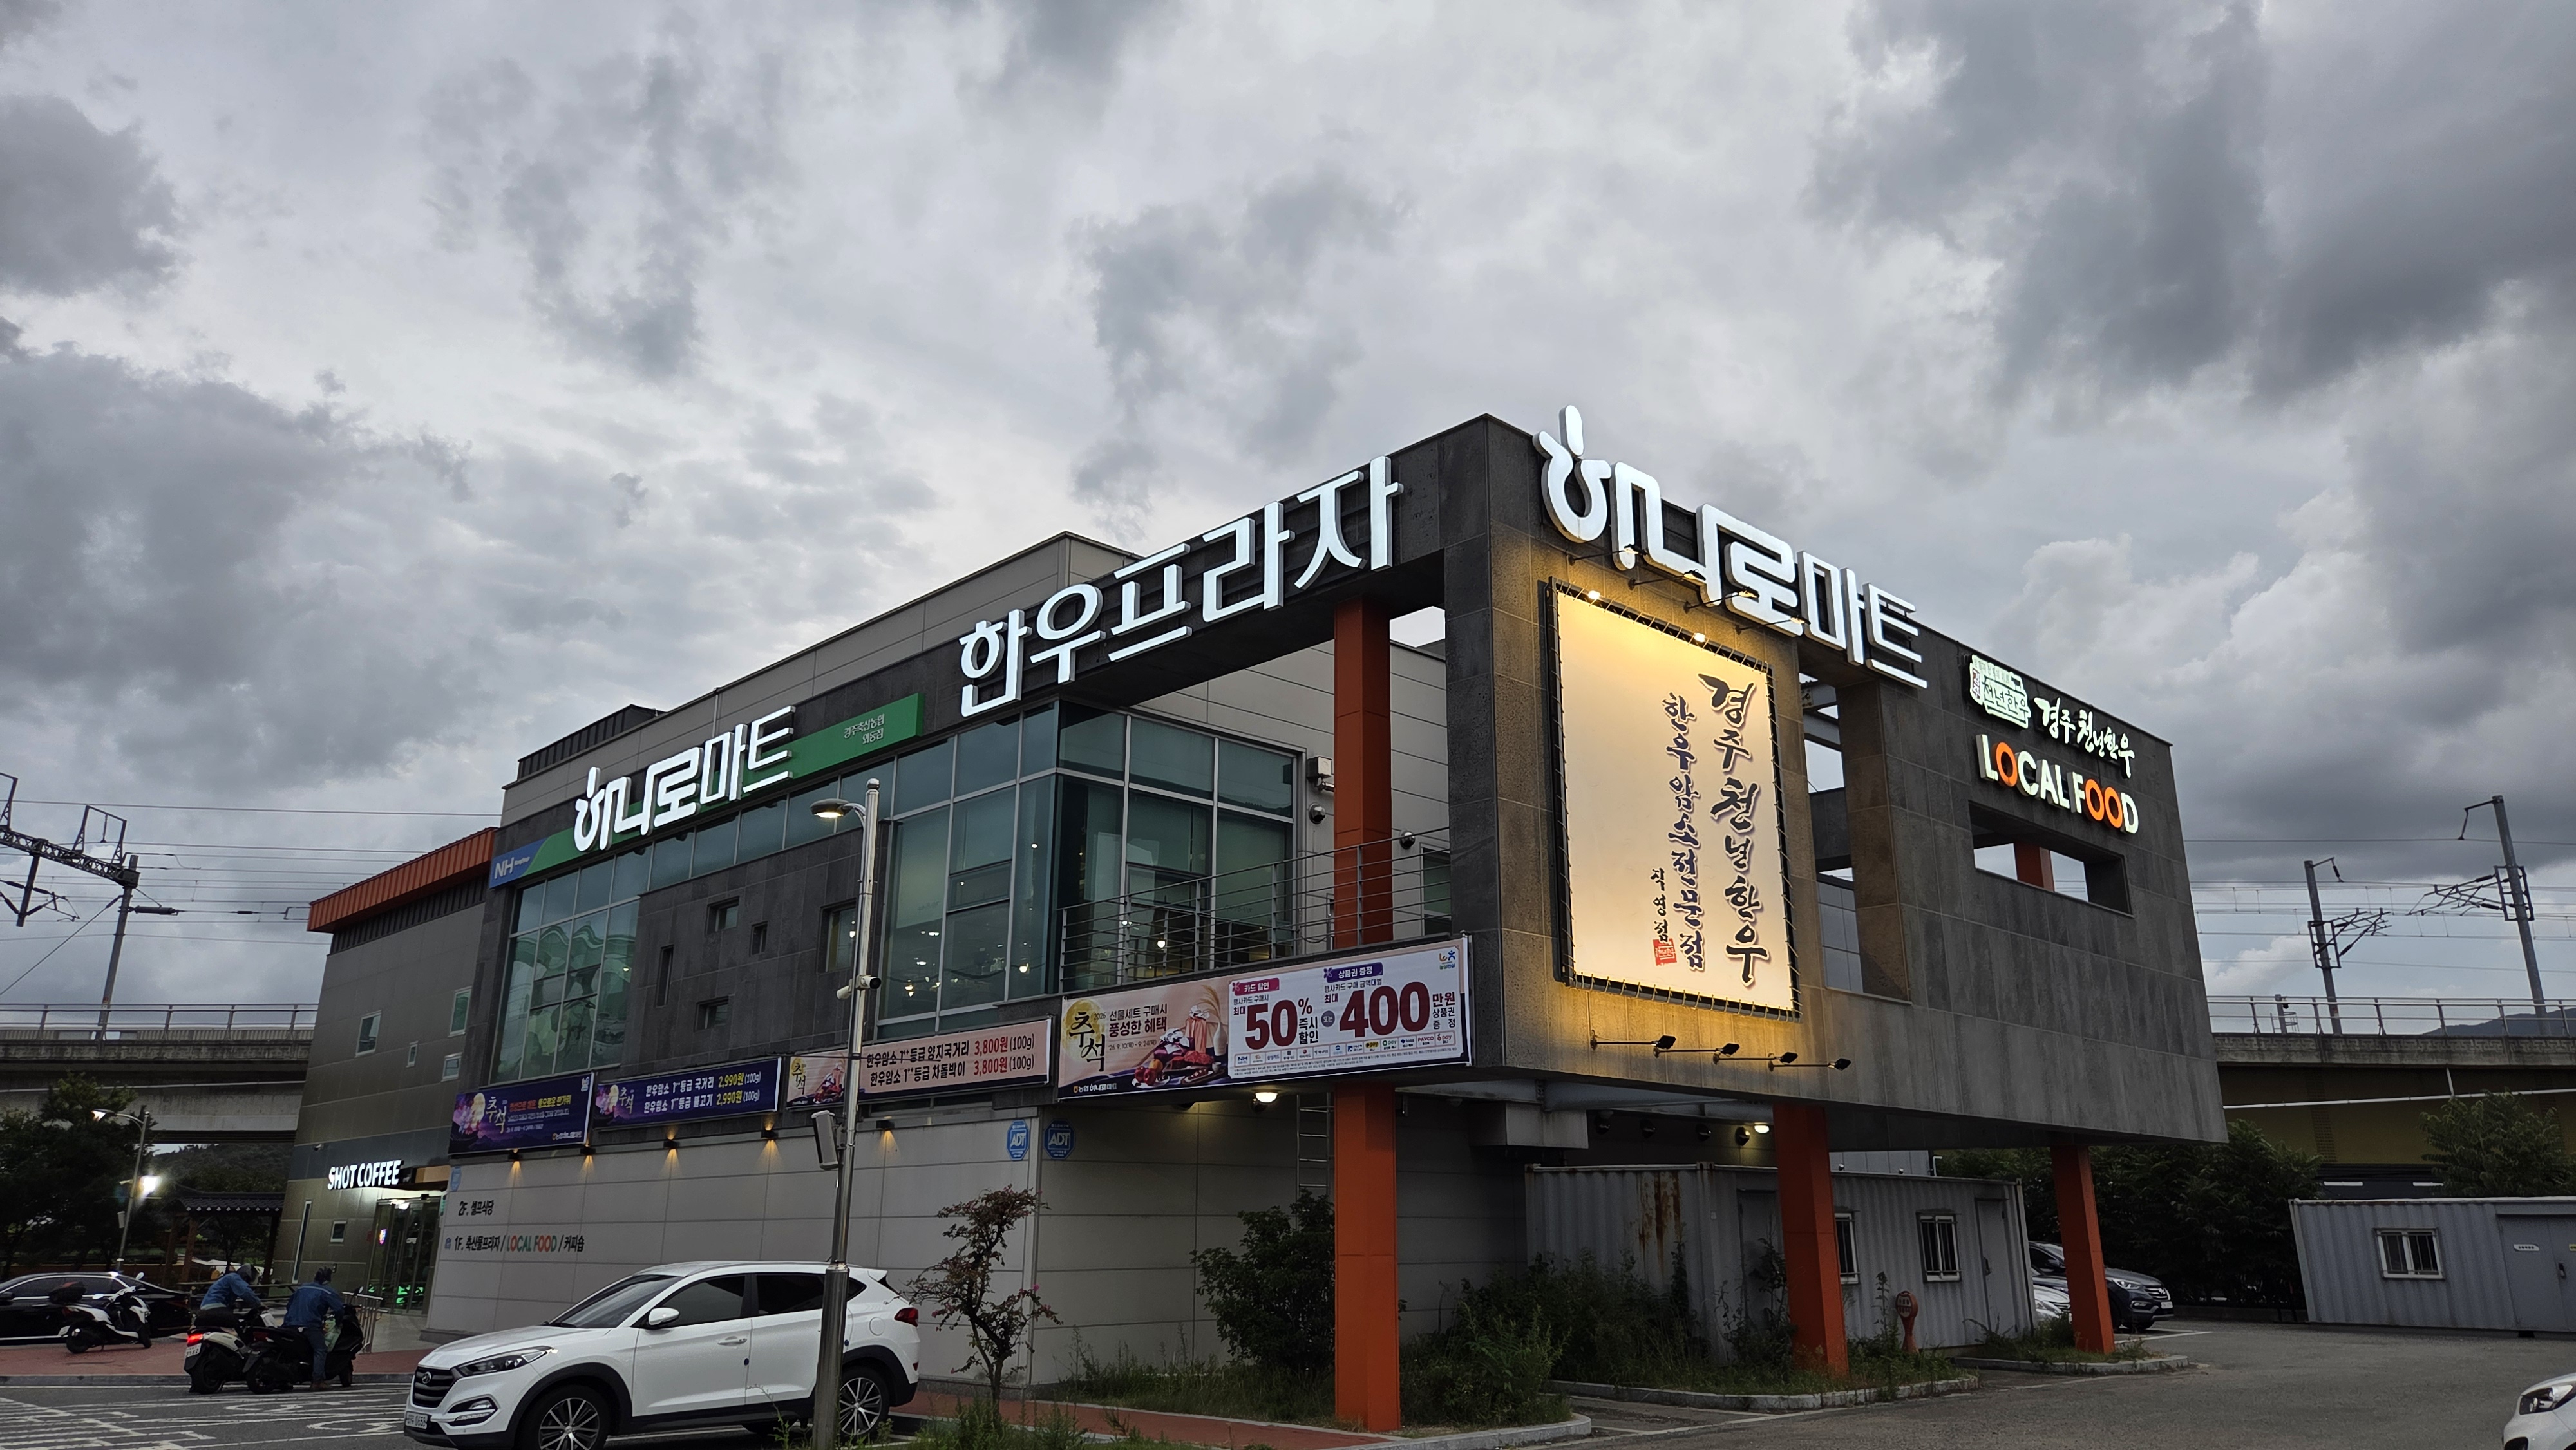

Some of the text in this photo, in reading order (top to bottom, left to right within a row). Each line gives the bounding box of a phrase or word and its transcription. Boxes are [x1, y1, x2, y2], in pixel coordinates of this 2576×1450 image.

[1533, 405, 1927, 689] 하나로마트
[960, 455, 1404, 717] 한우프라자
[574, 706, 796, 852] 하나로마트
[1976, 733, 2139, 834] LOCAL FOOD
[494, 857, 515, 880] NH
[1338, 966, 1373, 979] 상품권 증정
[1244, 982, 1269, 992] 카드 할인
[1324, 993, 1338, 1003] 최대
[1109, 1003, 1168, 1021] 선물세트 구매시
[1233, 1006, 1246, 1015] 최대
[1432, 1006, 1455, 1018] 상품권
[1109, 1017, 1168, 1037] 풍성한 혜택
[1298, 1016, 1318, 1030] 즉시
[1069, 1012, 1106, 1072] 추석
[1298, 1030, 1318, 1045] 할인
[791, 1063, 806, 1095] 추석
[870, 1069, 901, 1086] 한우암소
[932, 1061, 966, 1080] 차돌박이
[619, 1087, 635, 1114] 추석
[486, 1097, 507, 1134] 추석
[1010, 1132, 1027, 1147] ADT
[1048, 1132, 1070, 1146] ADT
[327, 1160, 401, 1191] SHOT COFFEE
[506, 1235, 532, 1252] LOCAL
[533, 1235, 558, 1252] FOOD
